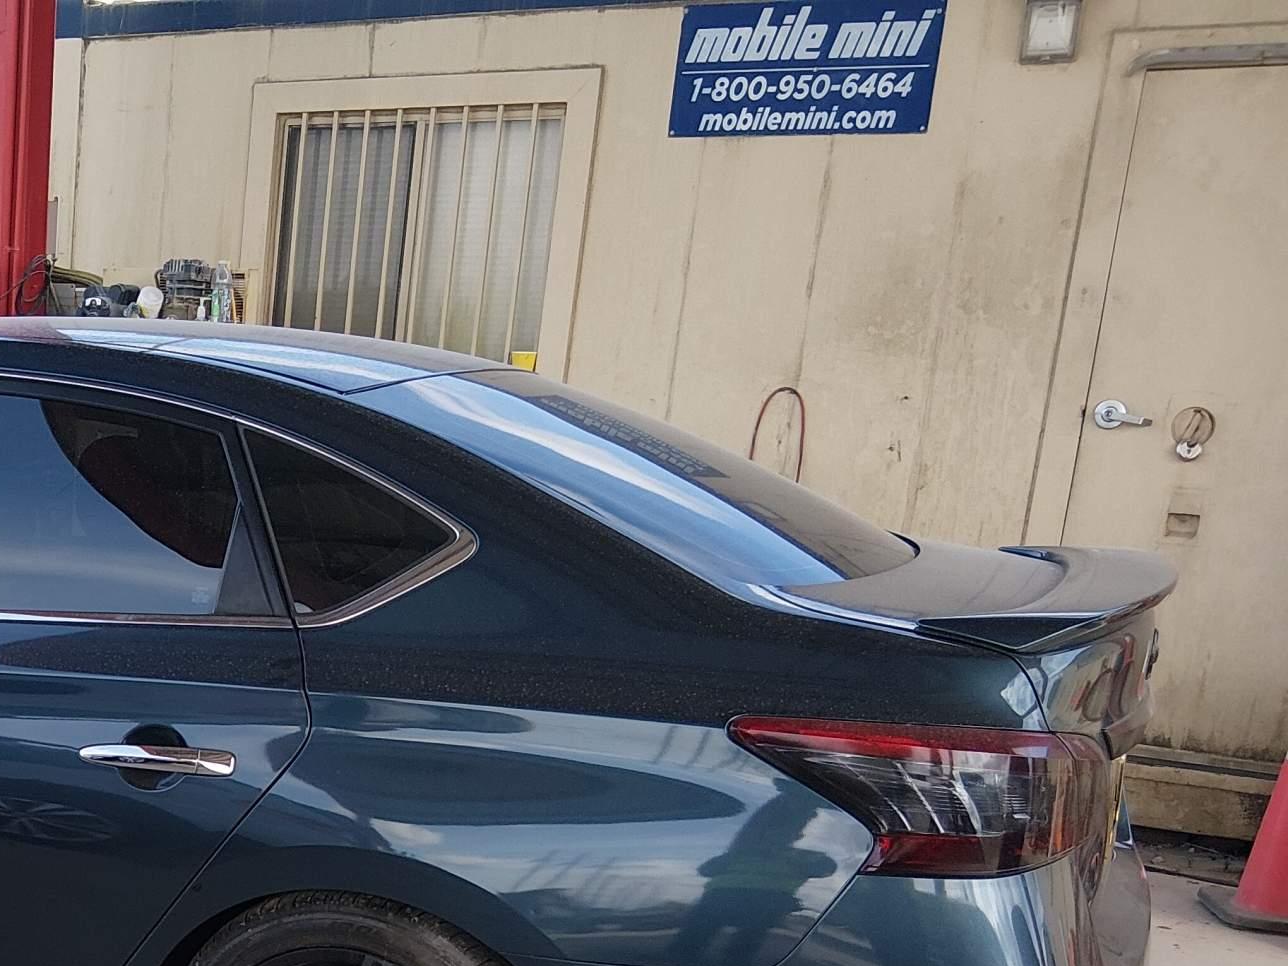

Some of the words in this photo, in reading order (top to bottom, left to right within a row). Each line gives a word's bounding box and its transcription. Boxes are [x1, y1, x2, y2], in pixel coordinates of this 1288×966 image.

[684, 5, 829, 64] mobile
[827, 9, 938, 59] mini
[689, 72, 916, 103] 1-800-950-6464
[697, 105, 897, 132] mobilemini.com
